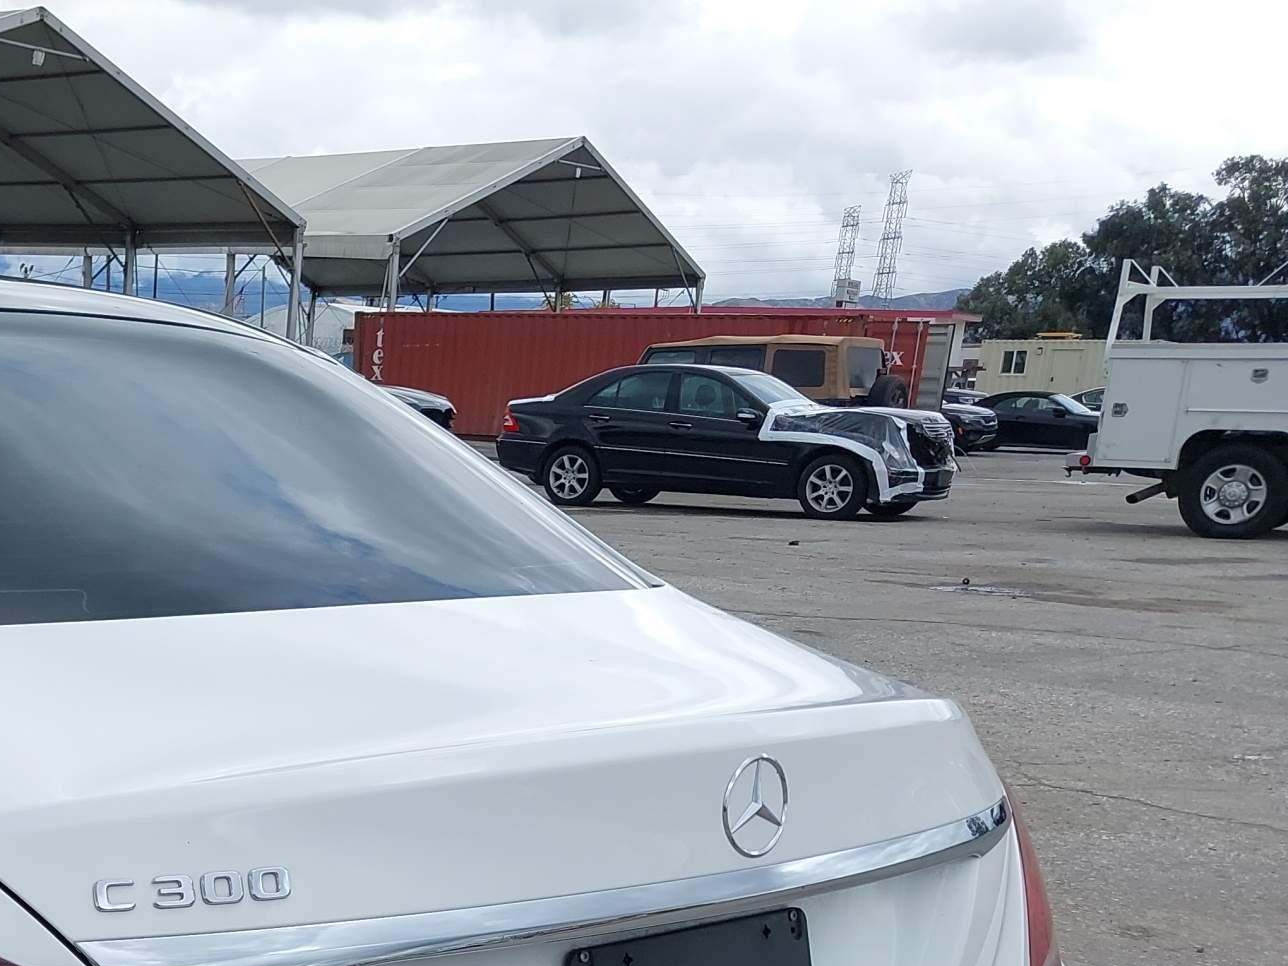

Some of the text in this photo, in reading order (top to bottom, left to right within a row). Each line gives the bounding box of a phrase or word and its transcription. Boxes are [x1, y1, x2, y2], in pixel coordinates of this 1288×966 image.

[371, 328, 385, 381] tex
[93, 866, 292, 912] C 300
